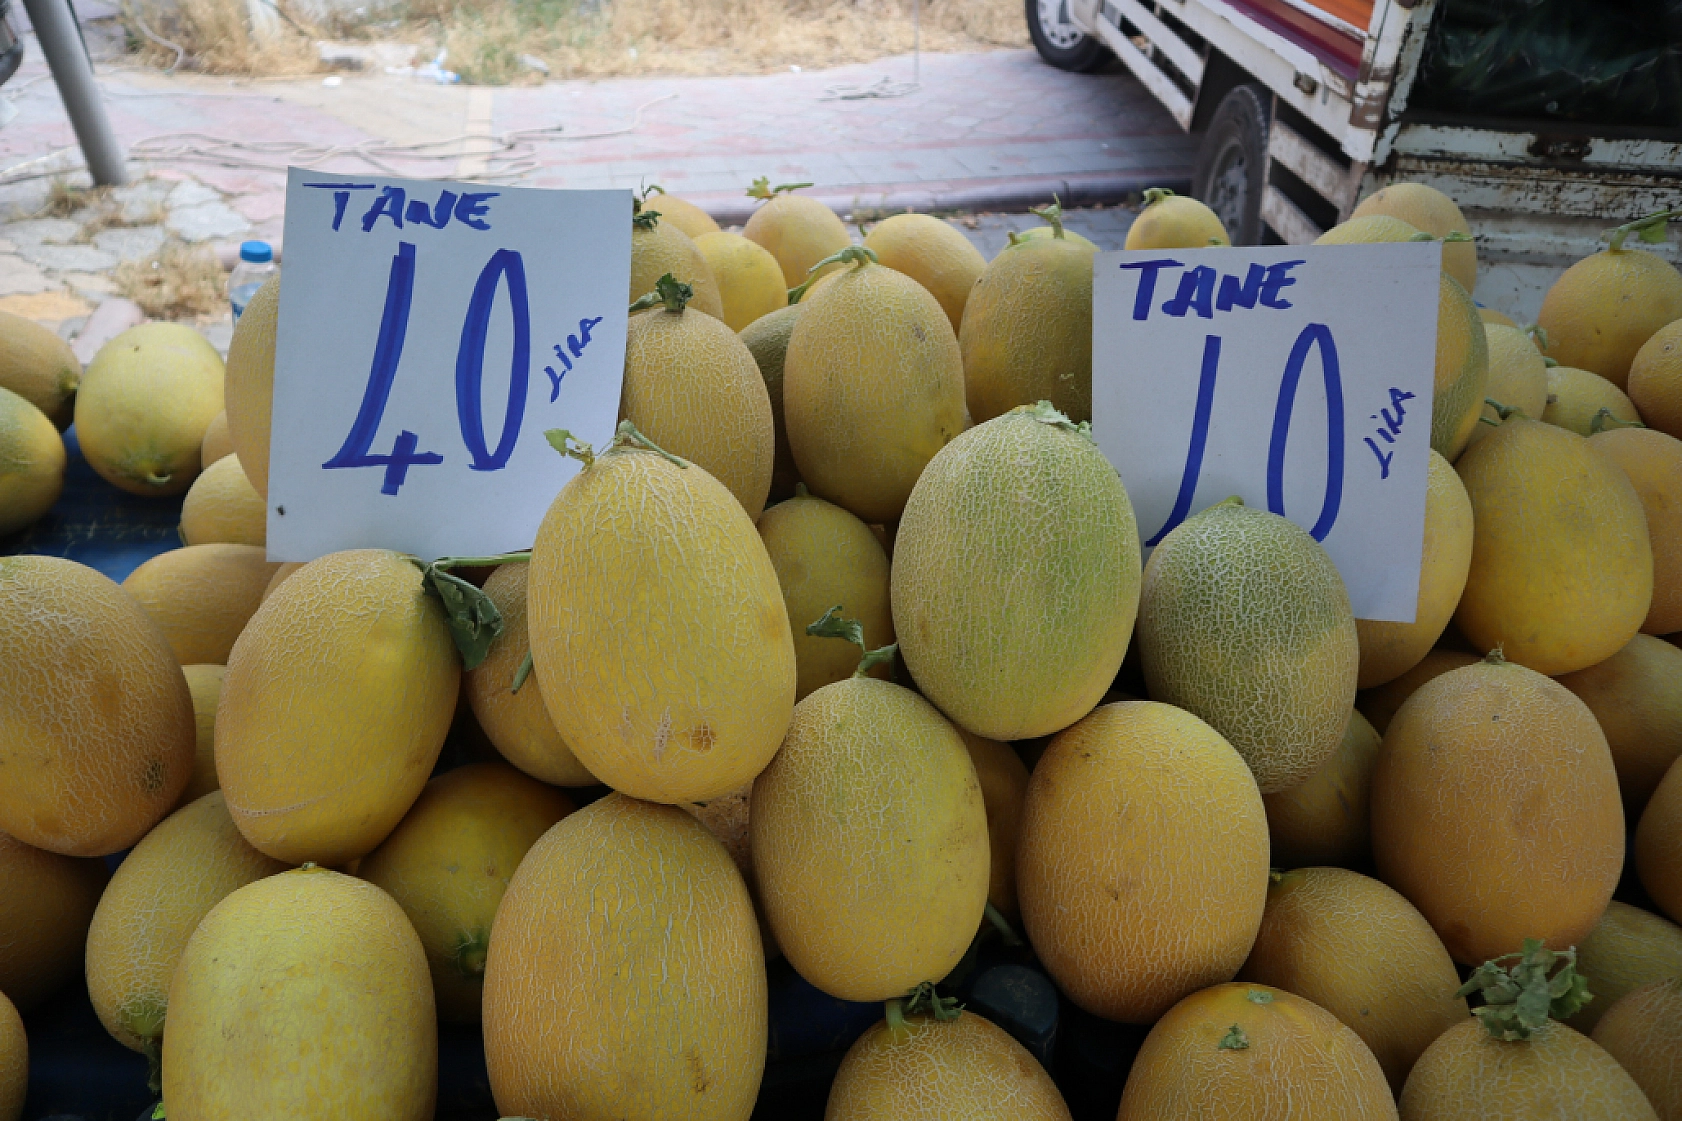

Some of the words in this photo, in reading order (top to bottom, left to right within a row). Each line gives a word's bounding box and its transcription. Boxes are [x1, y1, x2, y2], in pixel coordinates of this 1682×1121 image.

[302, 182, 501, 233] TANE
[1119, 259, 1307, 321] TANE
[321, 240, 531, 496] 40
